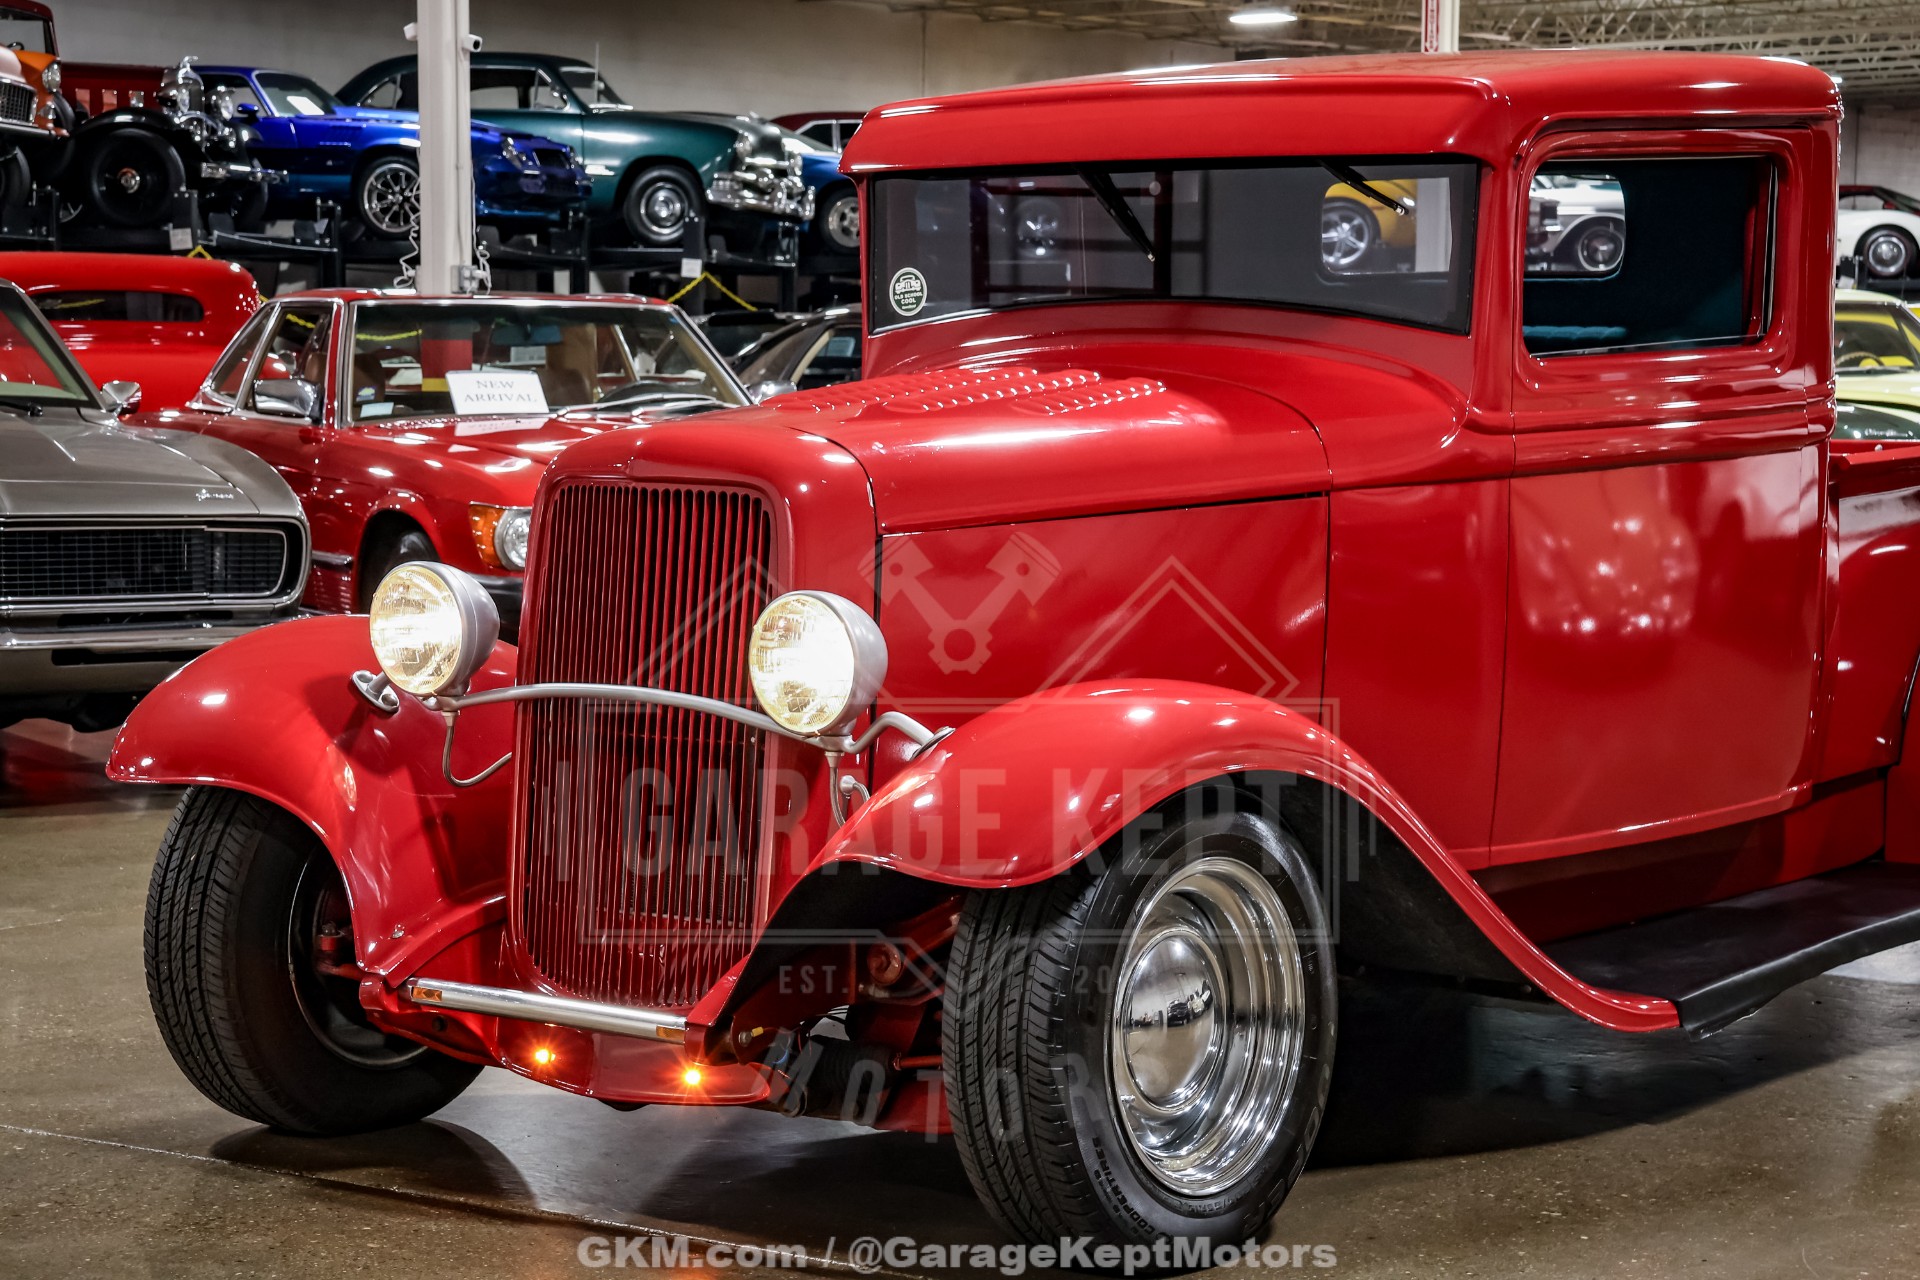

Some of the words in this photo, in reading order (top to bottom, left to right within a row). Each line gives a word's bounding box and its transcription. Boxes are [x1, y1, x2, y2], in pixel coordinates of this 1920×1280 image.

[904, 291, 923, 299] SCHOOL
[476, 380, 515, 389] NEW
[464, 393, 538, 403] ARRIVAL
